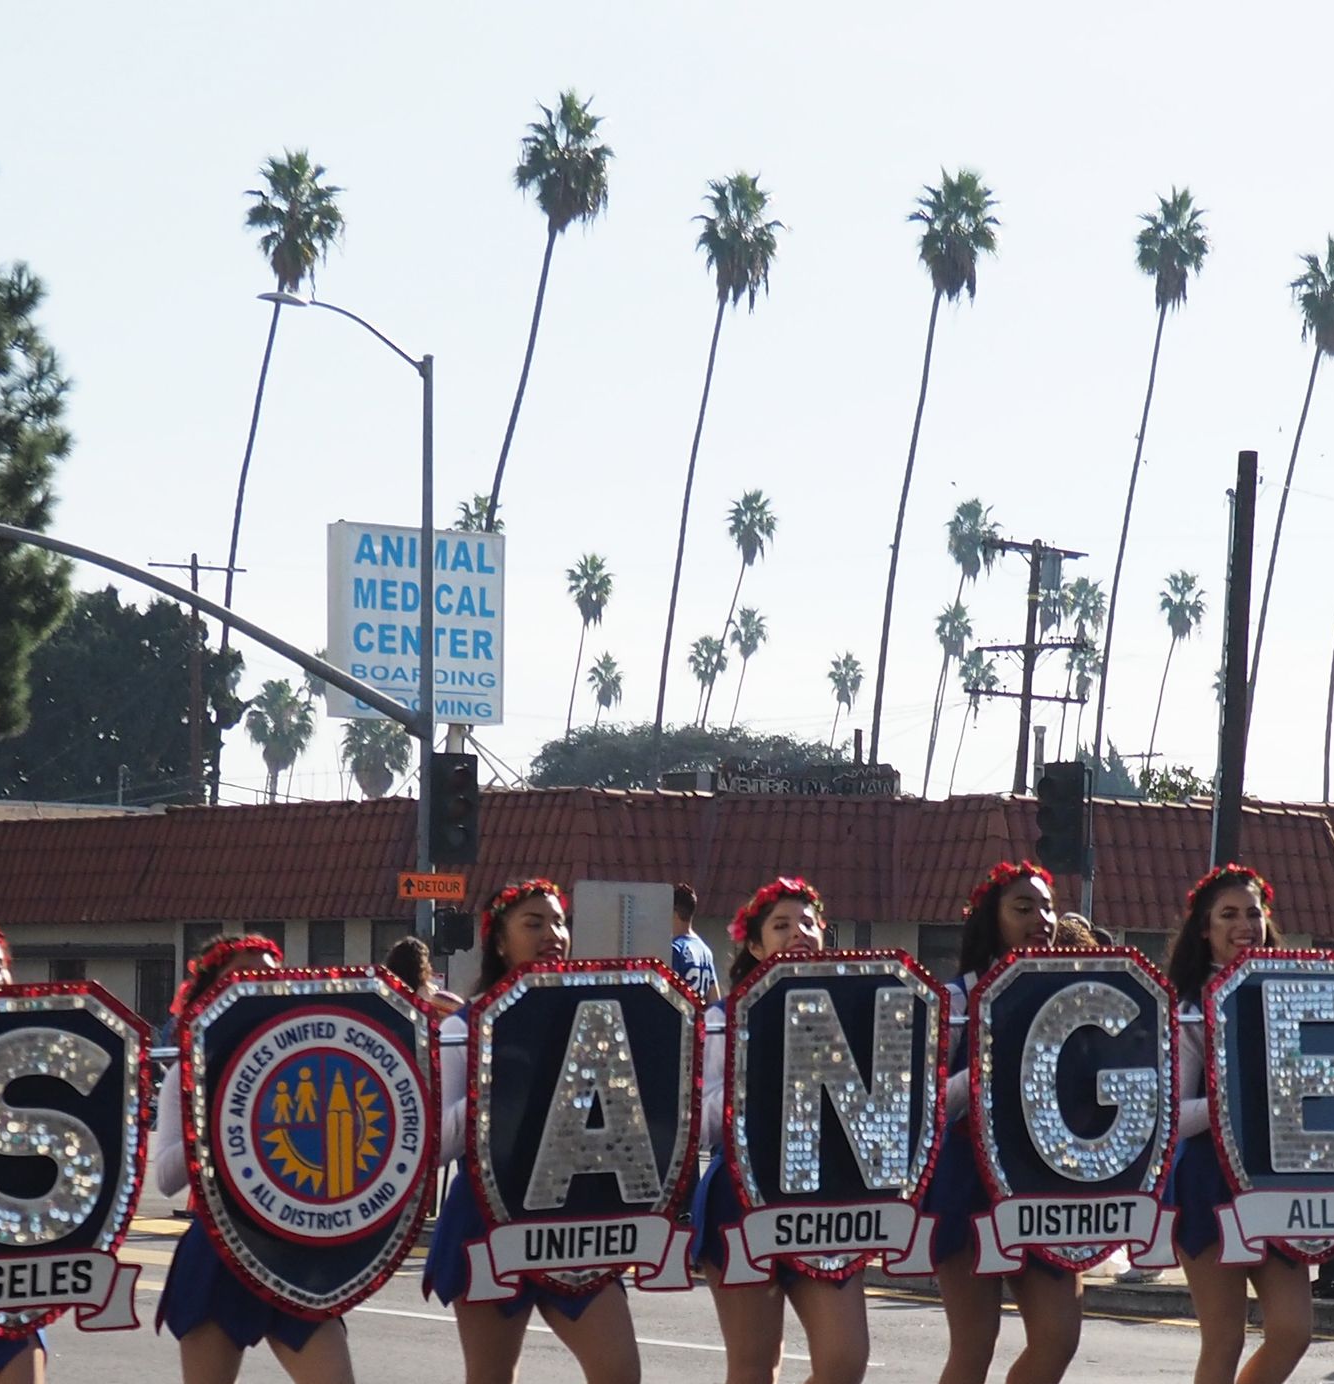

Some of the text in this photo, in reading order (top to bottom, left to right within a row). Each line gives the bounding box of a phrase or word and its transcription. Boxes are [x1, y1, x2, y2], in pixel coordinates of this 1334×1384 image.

[353, 577, 496, 618] MEDCAL
[417, 880, 461, 894] DETOUR
[226, 1021, 422, 1157] LOS ANGELES UNIFIED SCHOOL DISTRICT
[779, 988, 915, 1194] N
[1020, 981, 1158, 1182] G
[523, 1000, 664, 1211] A
[250, 1181, 396, 1231] ALL DISTRICT BAND
[775, 1210, 889, 1246] SCHOOL
[1019, 1201, 1137, 1236] DISTRICT
[524, 1223, 638, 1262] UNIFIED
